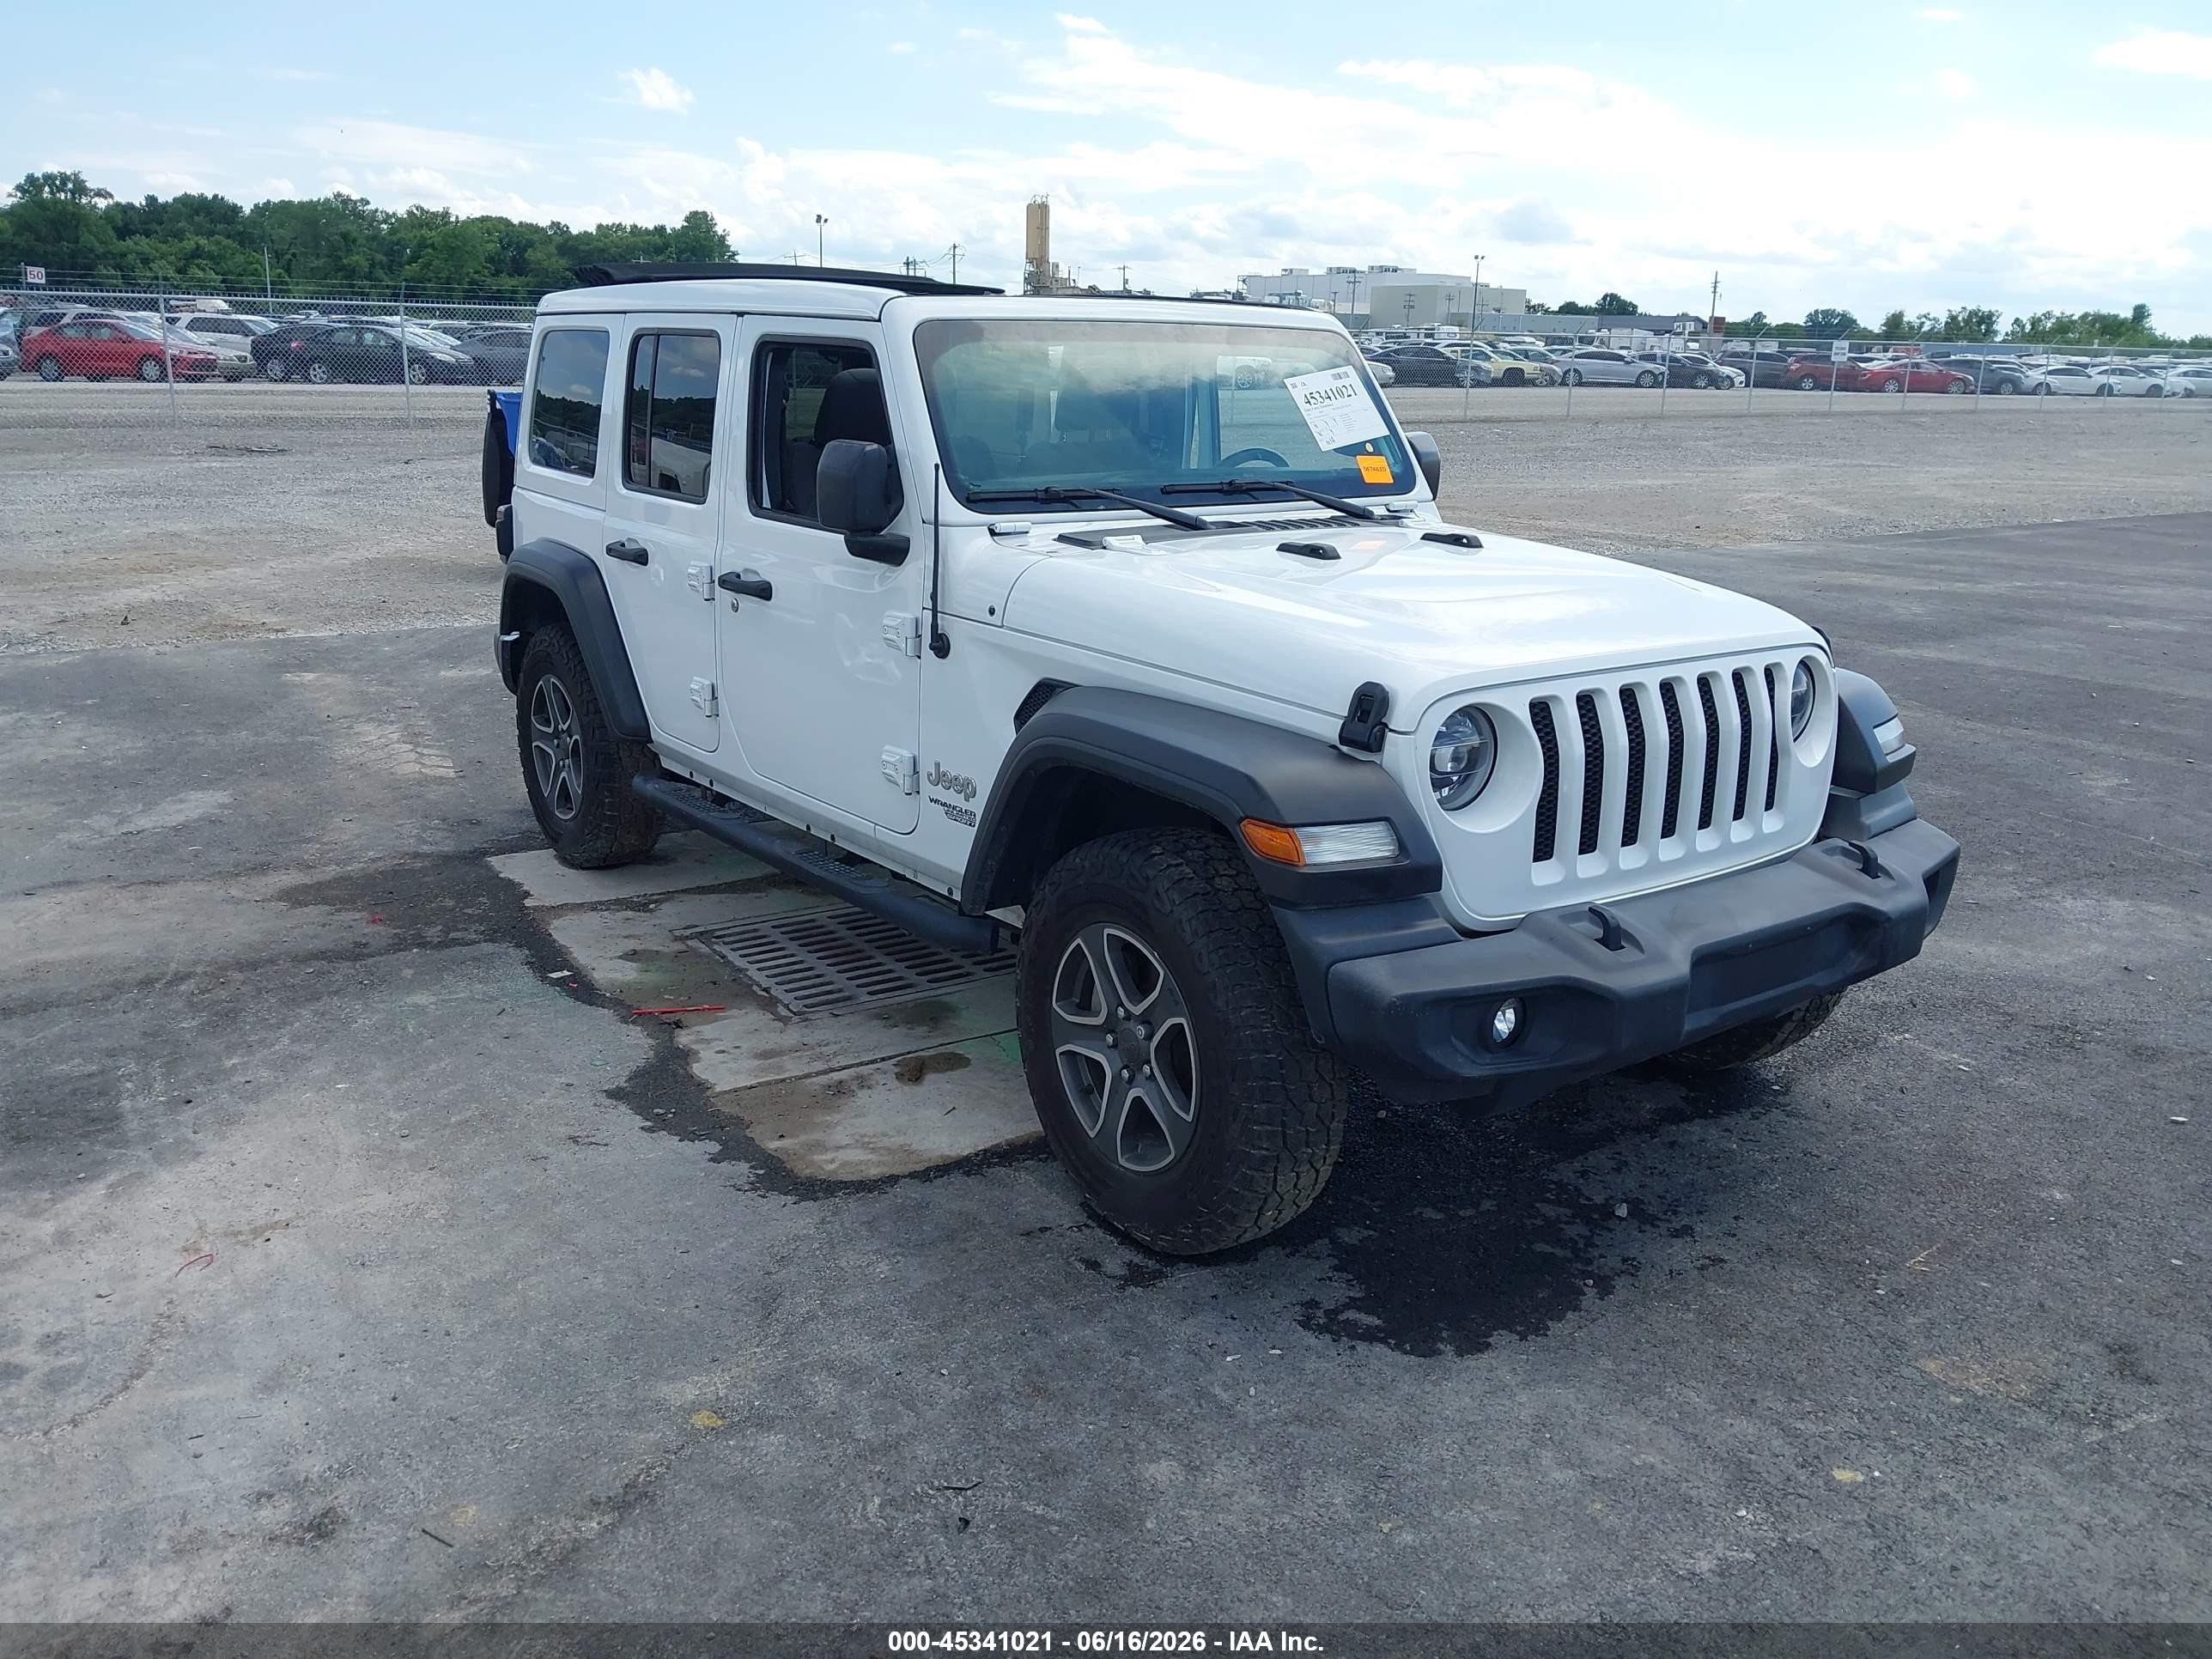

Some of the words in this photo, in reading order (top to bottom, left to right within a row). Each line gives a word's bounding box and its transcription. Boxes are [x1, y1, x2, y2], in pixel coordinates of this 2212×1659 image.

[28, 270, 44, 281] 50
[1304, 383, 1358, 406] 45341021
[927, 760, 977, 803] Jeep
[928, 795, 976, 818] WRANGLER
